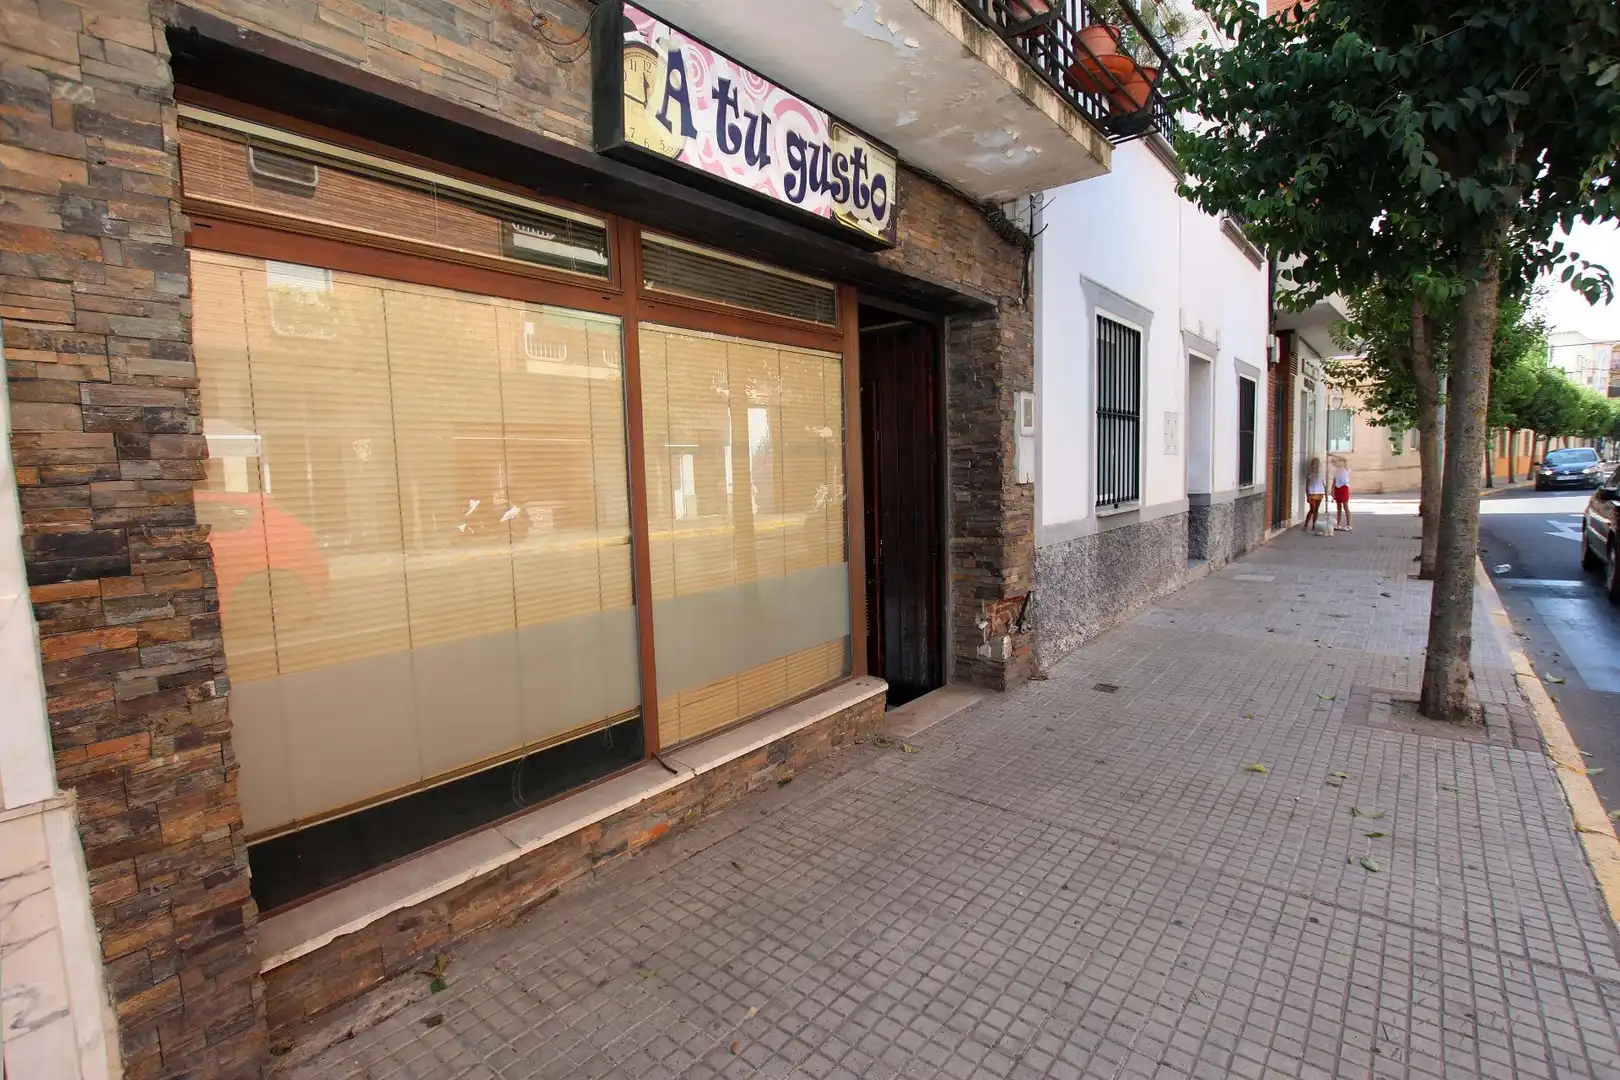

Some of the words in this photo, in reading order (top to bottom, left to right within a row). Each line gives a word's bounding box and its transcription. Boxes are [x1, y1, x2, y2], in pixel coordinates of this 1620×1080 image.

[643, 60, 652, 73] 12
[630, 127, 636, 138] 7
[655, 49, 697, 140] A
[712, 76, 771, 171] tu
[784, 129, 887, 221] gusto
[660, 139, 666, 151] 5
